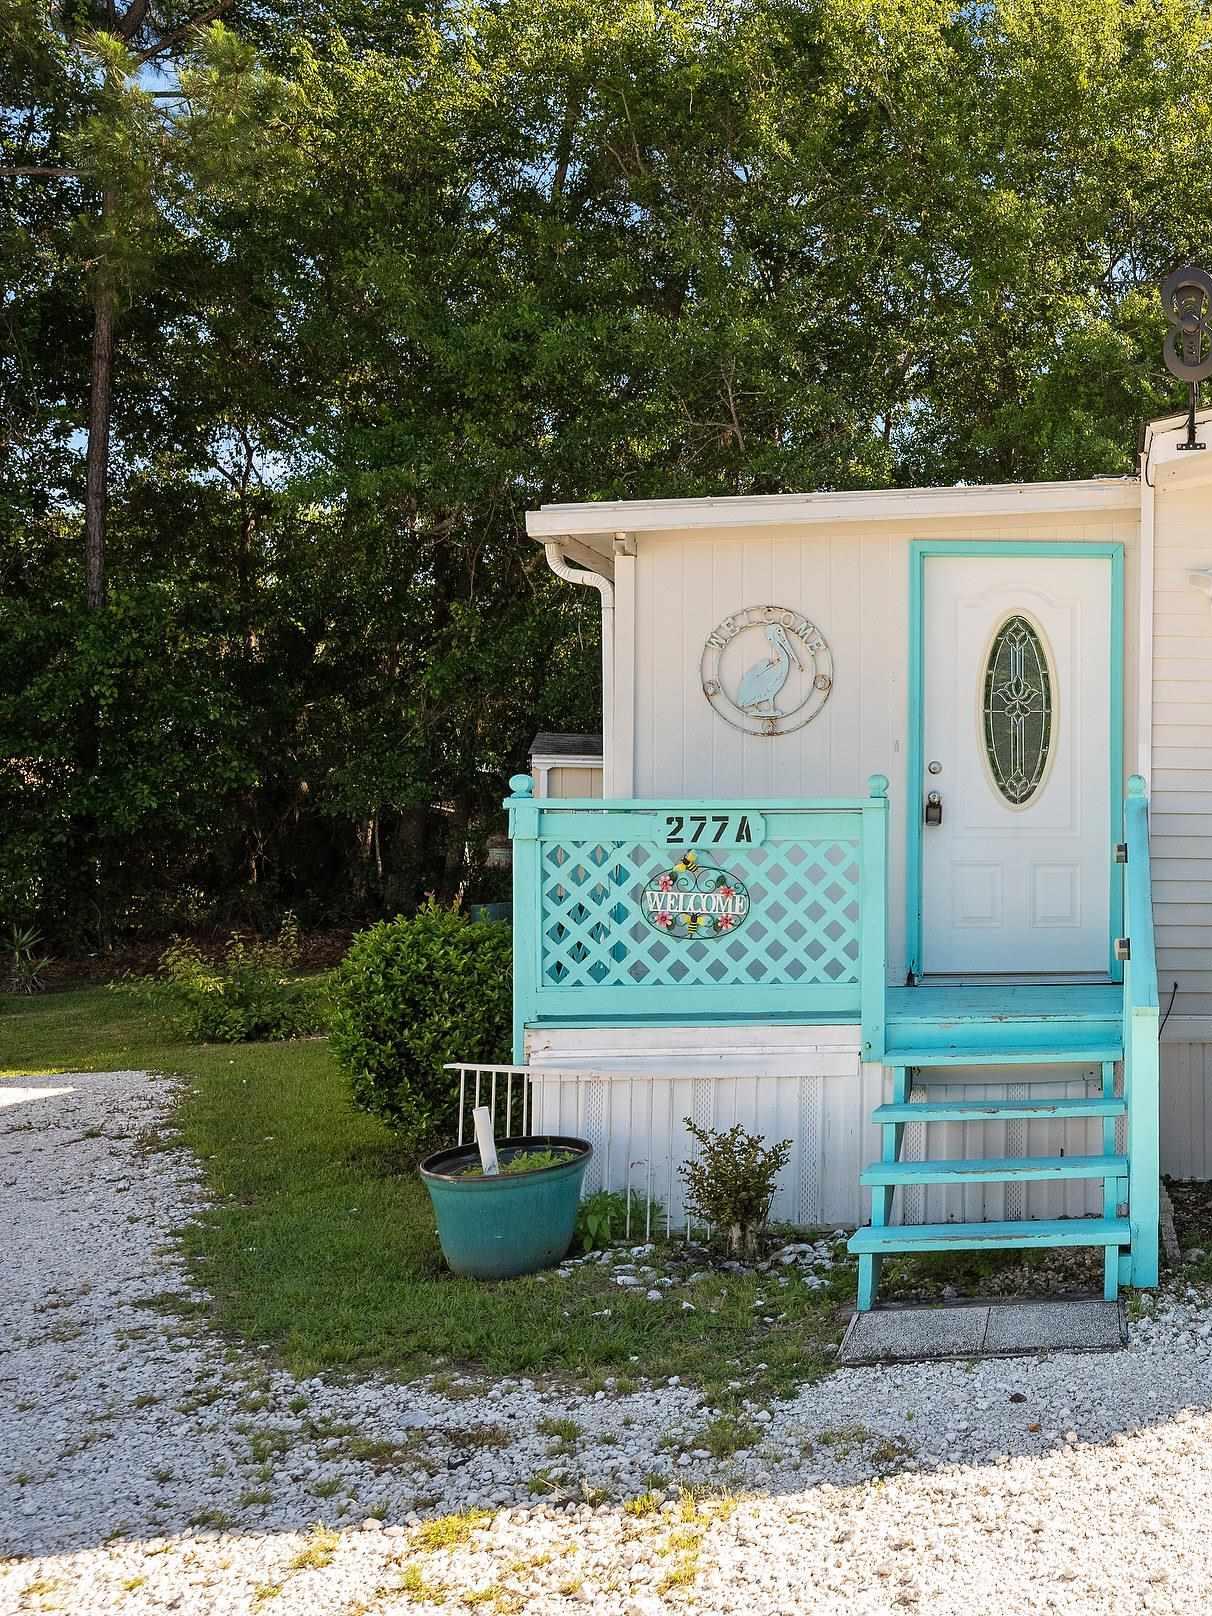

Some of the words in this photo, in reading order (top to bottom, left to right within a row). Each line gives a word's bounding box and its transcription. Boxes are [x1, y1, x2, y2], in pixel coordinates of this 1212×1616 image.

[704, 607, 827, 655] WELCOME
[666, 815, 752, 843] 277A
[646, 891, 748, 914] WELCOME
